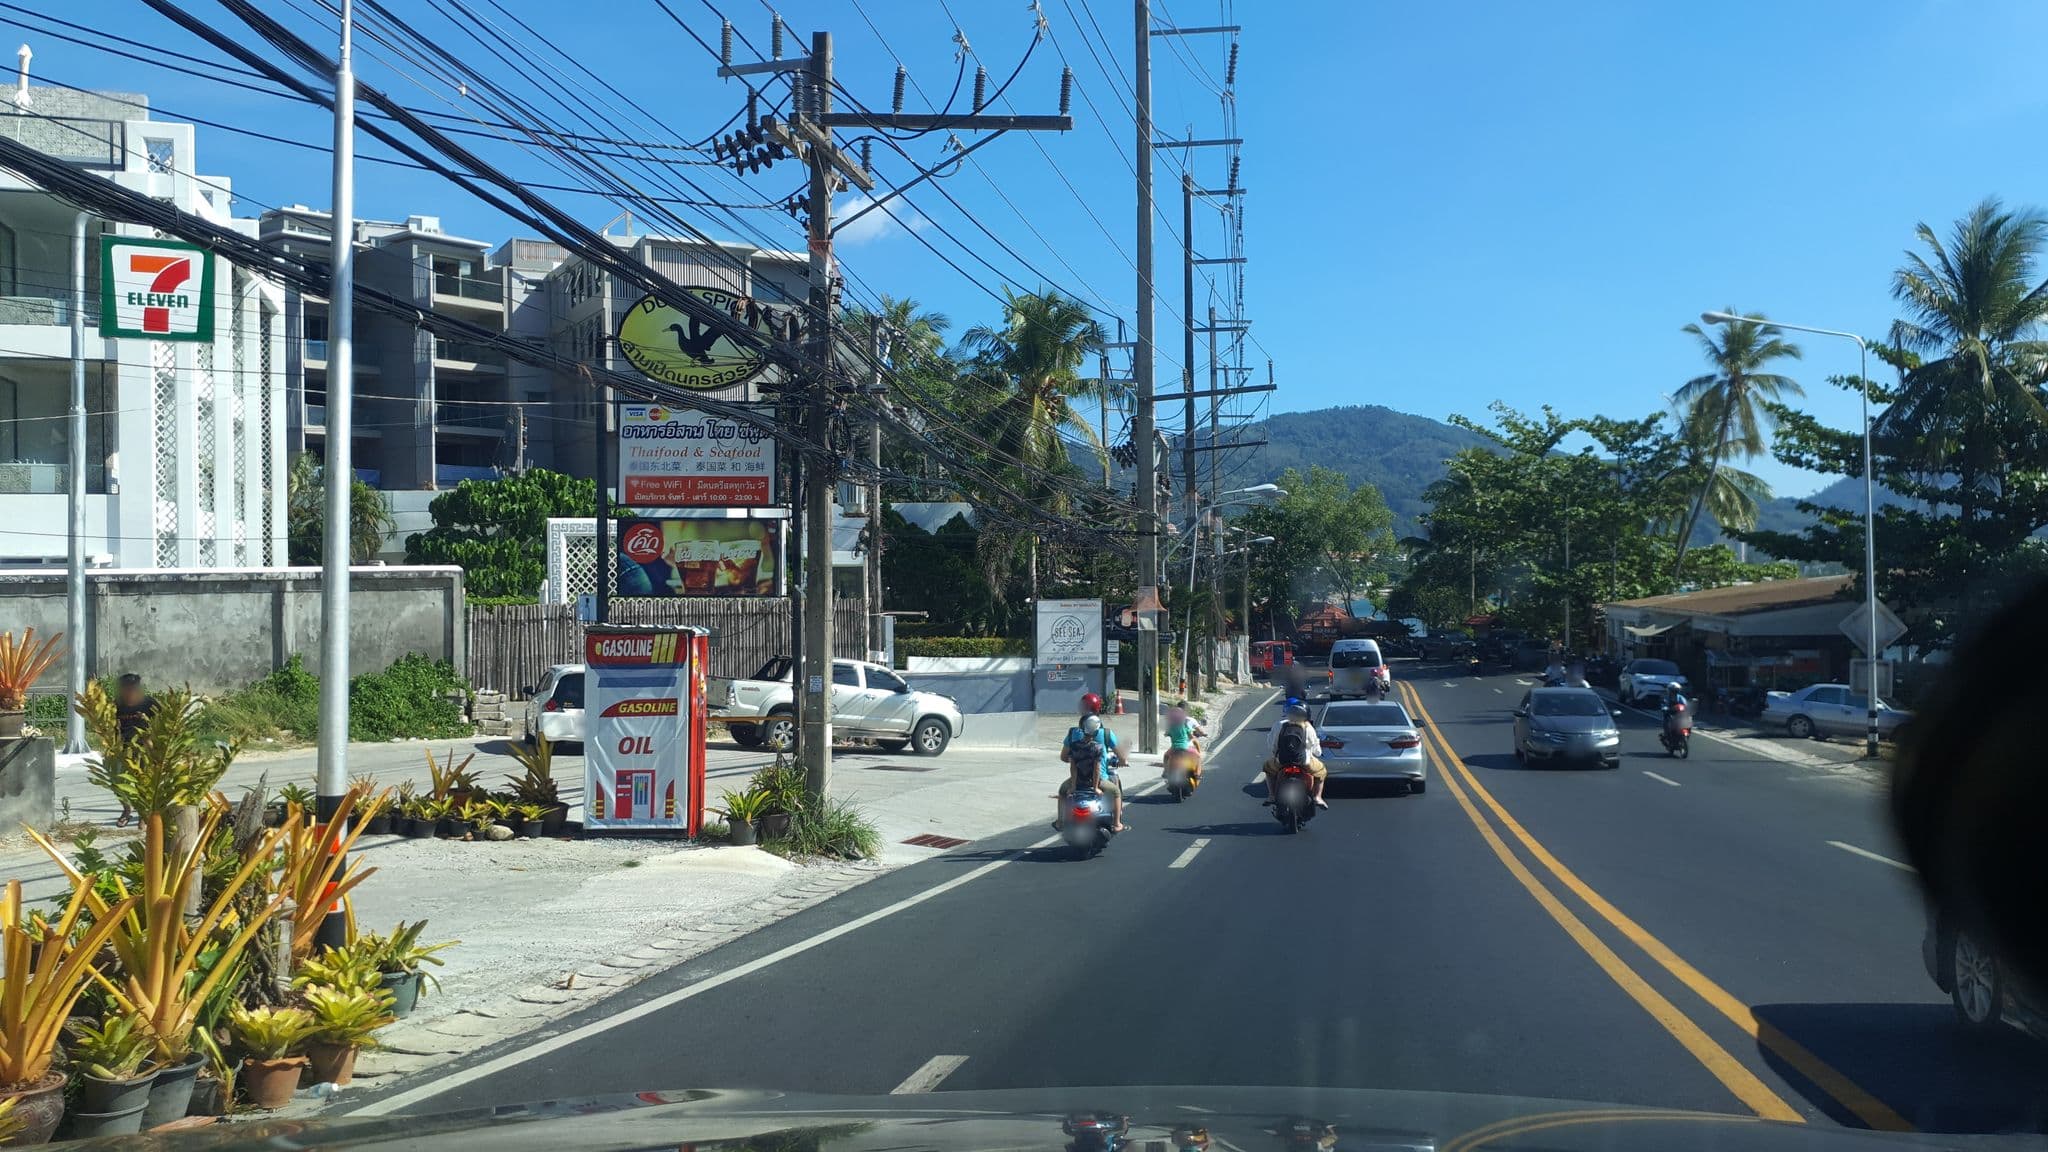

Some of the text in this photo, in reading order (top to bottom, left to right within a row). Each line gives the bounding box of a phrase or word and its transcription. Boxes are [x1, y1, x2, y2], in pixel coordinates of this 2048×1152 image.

[130, 254, 190, 332] 7
[622, 421, 704, 439] อาหารอีสาน
[707, 420, 735, 439] ไทย
[630, 447, 761, 460] Thaifood & Seafood
[731, 461, 741, 471] 和
[641, 480, 661, 489] Free
[663, 480, 683, 489] WiFi
[602, 639, 653, 657] GASOLINE
[619, 703, 677, 713] GASOLINE
[618, 736, 654, 755] OIL
